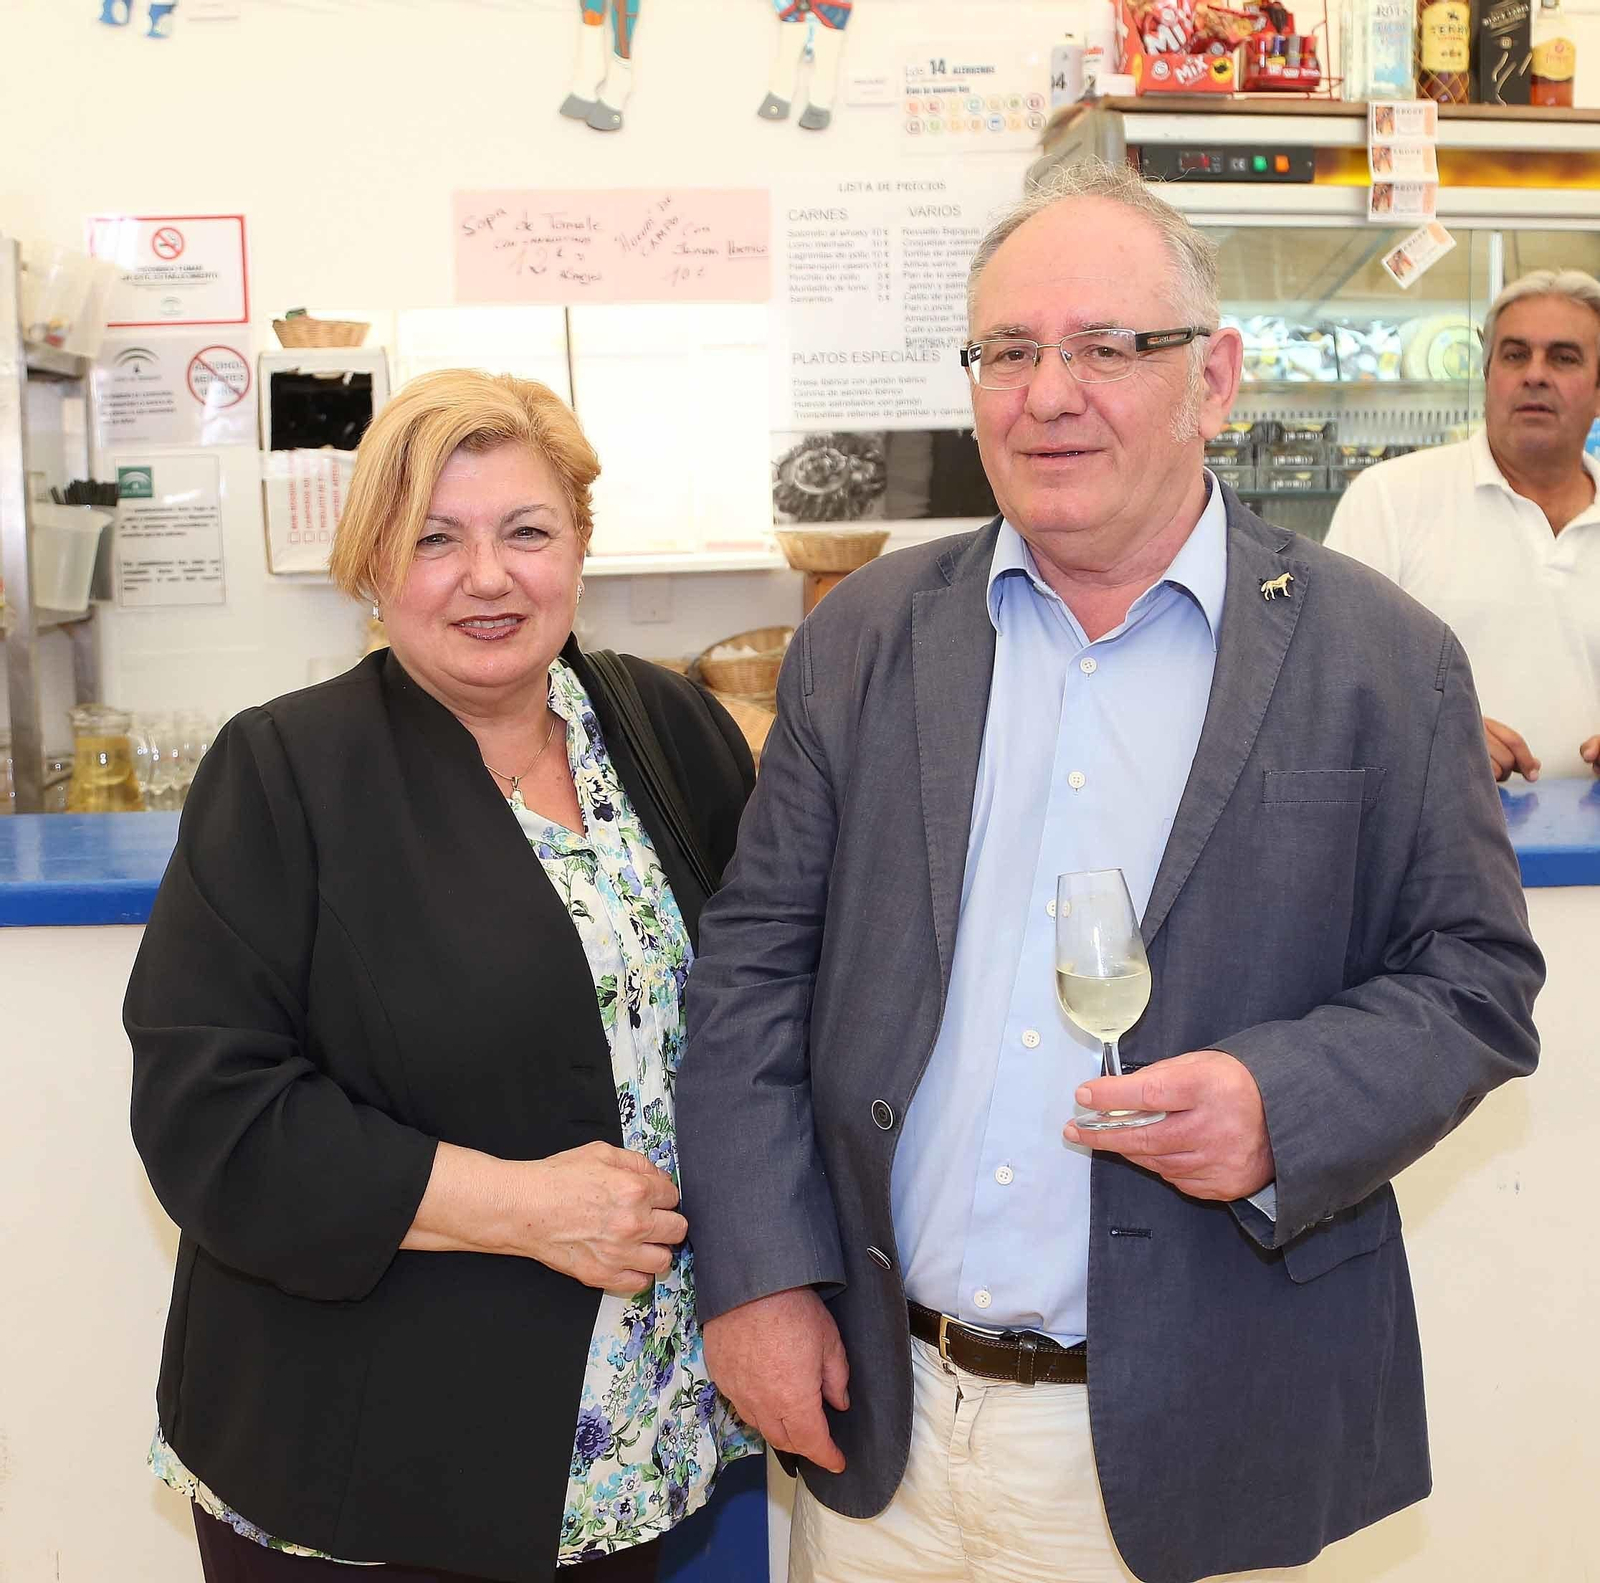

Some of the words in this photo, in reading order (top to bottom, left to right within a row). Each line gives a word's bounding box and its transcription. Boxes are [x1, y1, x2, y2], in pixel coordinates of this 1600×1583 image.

[930, 58, 947, 75] 14
[838, 181, 874, 193] LISTA
[877, 181, 891, 193] DE
[896, 180, 947, 192] PRECIOS
[787, 209, 849, 222] CARNES
[907, 205, 961, 218] VARIOS
[792, 352, 848, 365] PLATOS
[852, 349, 941, 363] ESPECIALES
